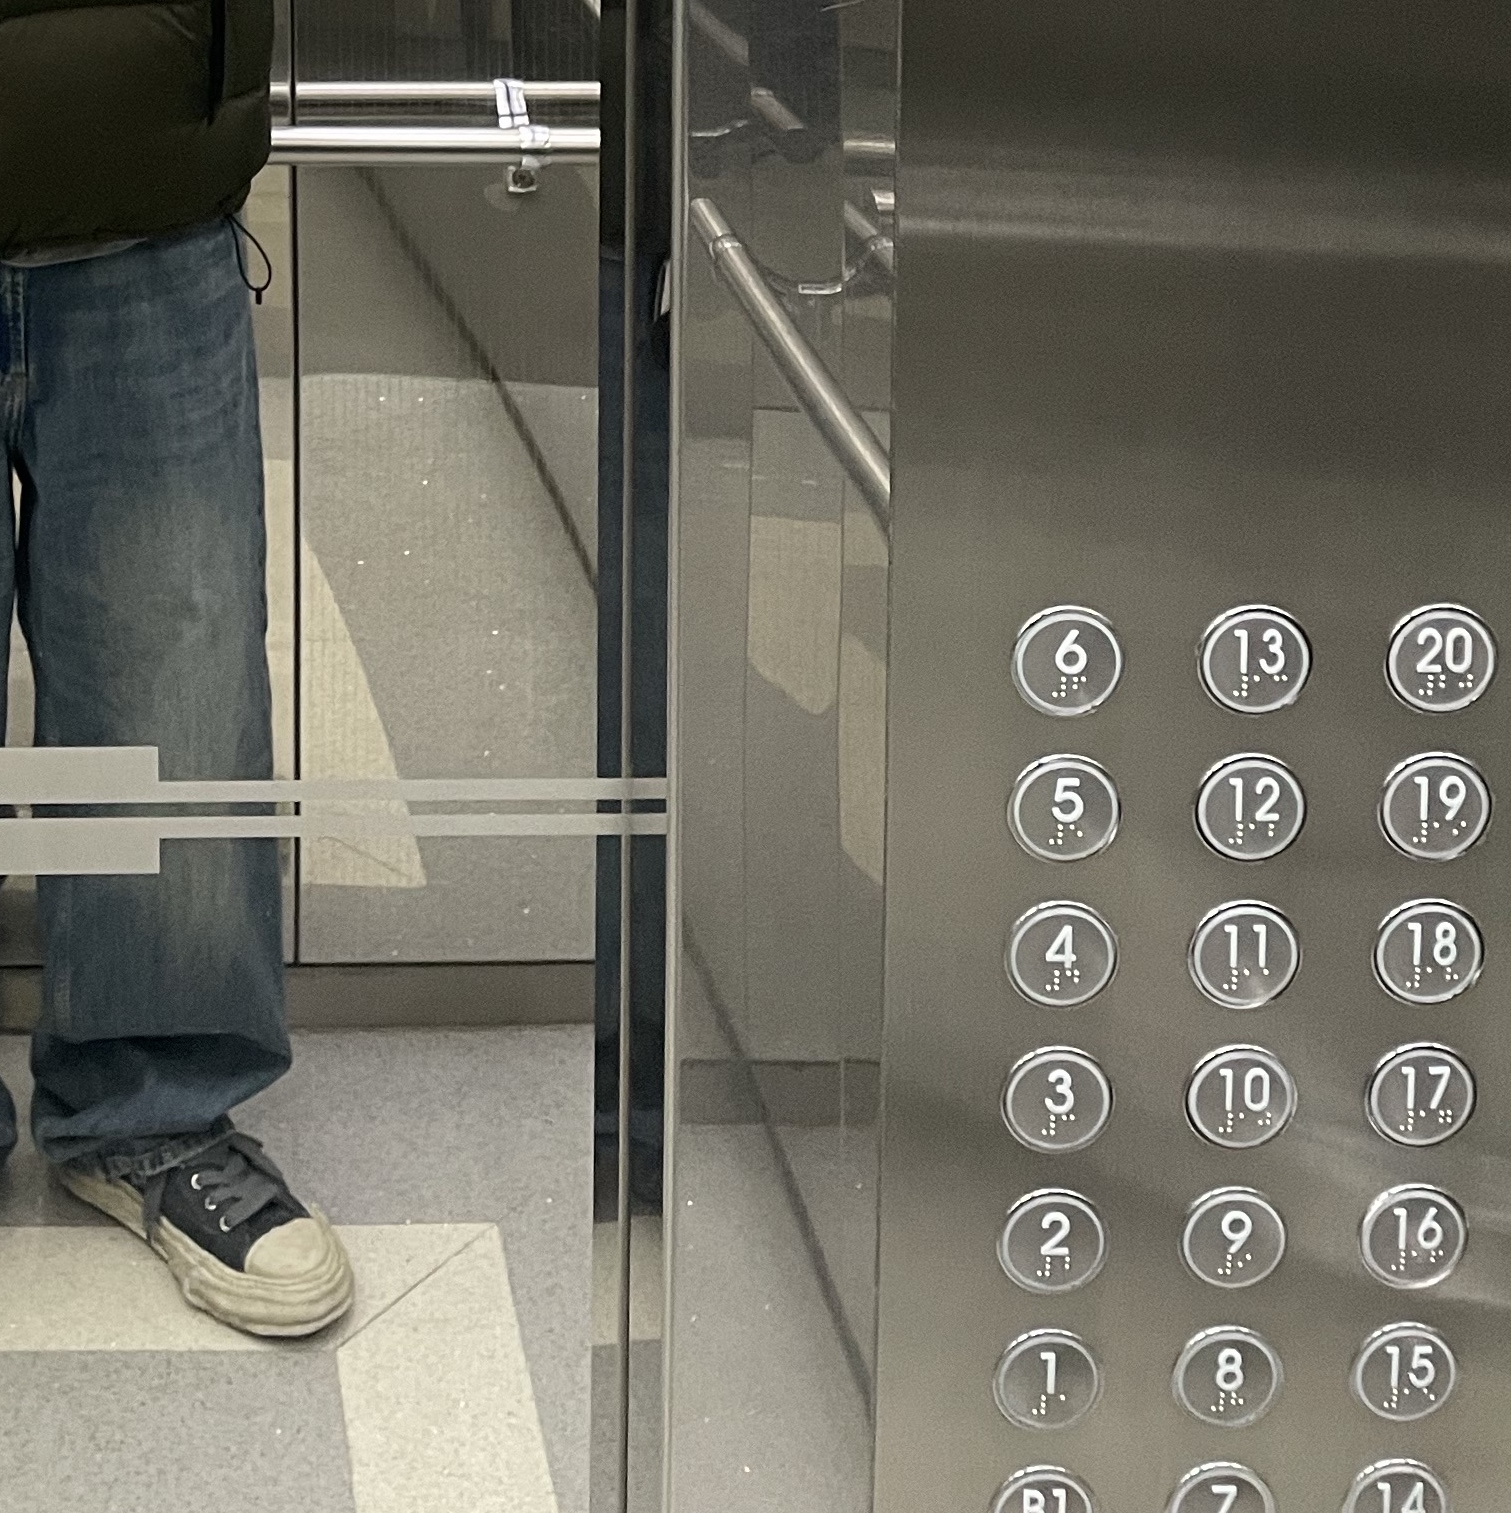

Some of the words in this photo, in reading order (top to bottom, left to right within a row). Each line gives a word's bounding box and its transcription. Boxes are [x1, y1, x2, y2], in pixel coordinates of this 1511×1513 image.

[1054, 628, 1088, 676] 6
[1233, 628, 1287, 676] 13
[1415, 626, 1474, 675] 20
[1051, 777, 1085, 824] 5
[1228, 776, 1281, 823] 12
[1412, 774, 1467, 822] 19
[1045, 924, 1078, 970] 4
[1223, 923, 1269, 969] 11
[1407, 922, 1458, 967] 18
[1043, 1068, 1075, 1115] 3
[1218, 1066, 1271, 1114] 10
[1400, 1065, 1452, 1111] 17
[1039, 1211, 1072, 1257] 2
[1220, 1209, 1253, 1255] 9
[1392, 1206, 1444, 1252] 16
[1038, 1351, 1057, 1396] 1
[1214, 1348, 1245, 1392] 8
[1385, 1345, 1437, 1389] 15
[1376, 1481, 1426, 1513] 14
